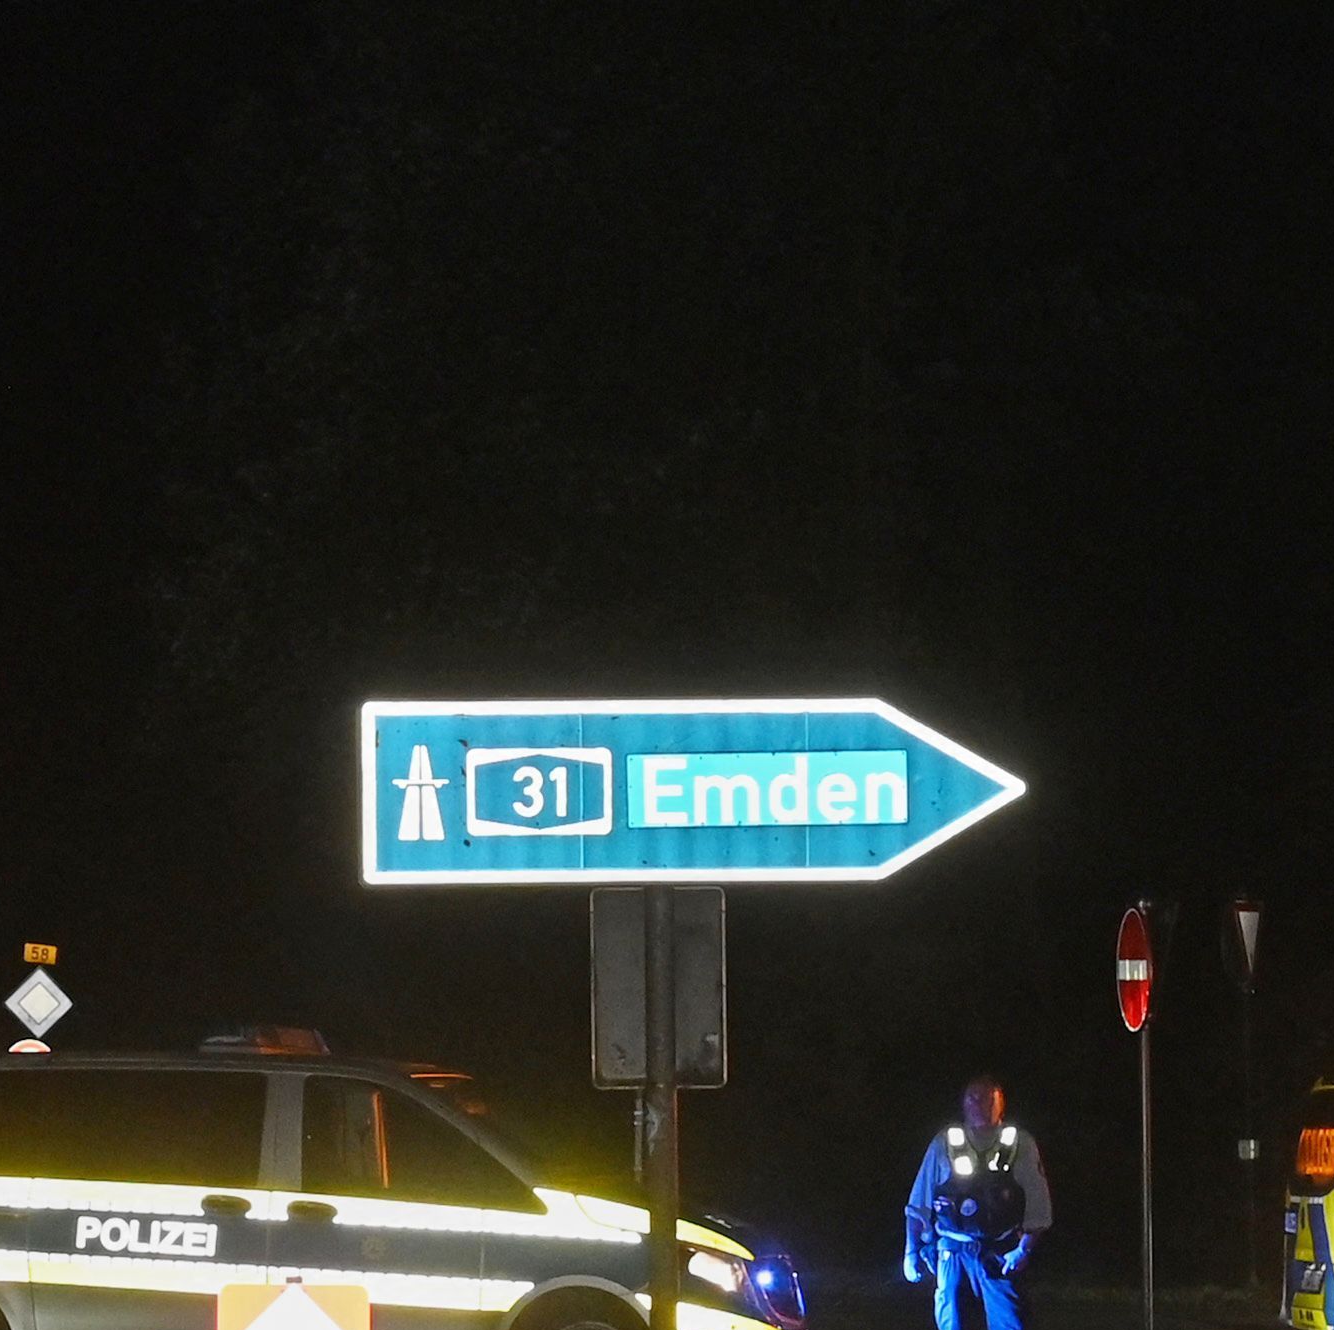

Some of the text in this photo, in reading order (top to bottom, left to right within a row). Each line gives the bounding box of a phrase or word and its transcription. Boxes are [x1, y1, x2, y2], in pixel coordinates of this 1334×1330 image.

[512, 756, 907, 825] 31 Emden
[30, 946, 50, 962] 58
[75, 1215, 218, 1257] POLIZEI
